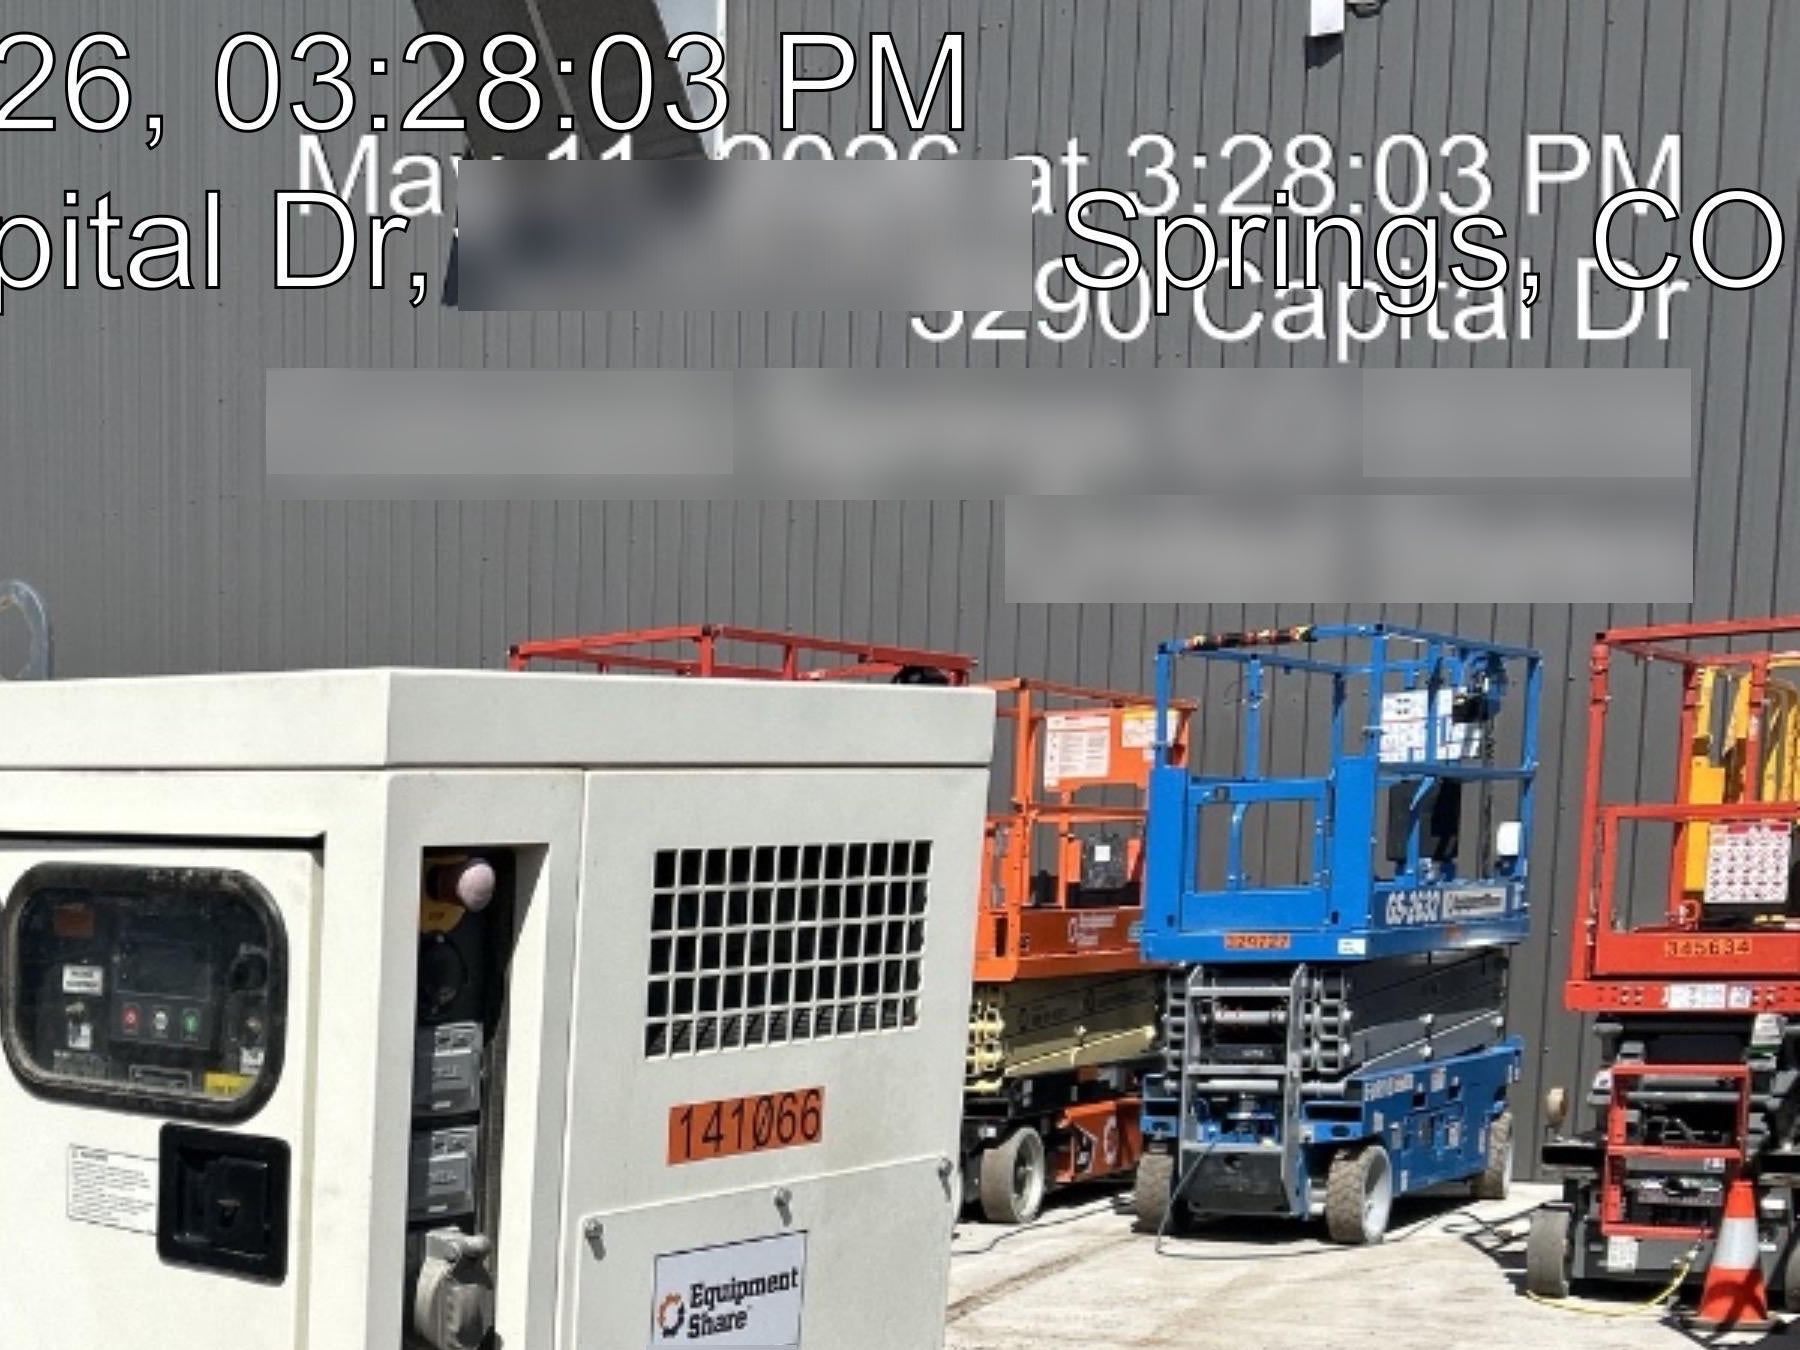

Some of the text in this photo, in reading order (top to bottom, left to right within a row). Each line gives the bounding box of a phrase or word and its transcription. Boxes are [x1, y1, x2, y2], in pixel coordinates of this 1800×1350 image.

[679, 1088, 821, 1160] 141066
[689, 1266, 799, 1311] Equipment
[686, 1310, 749, 1339] Share
